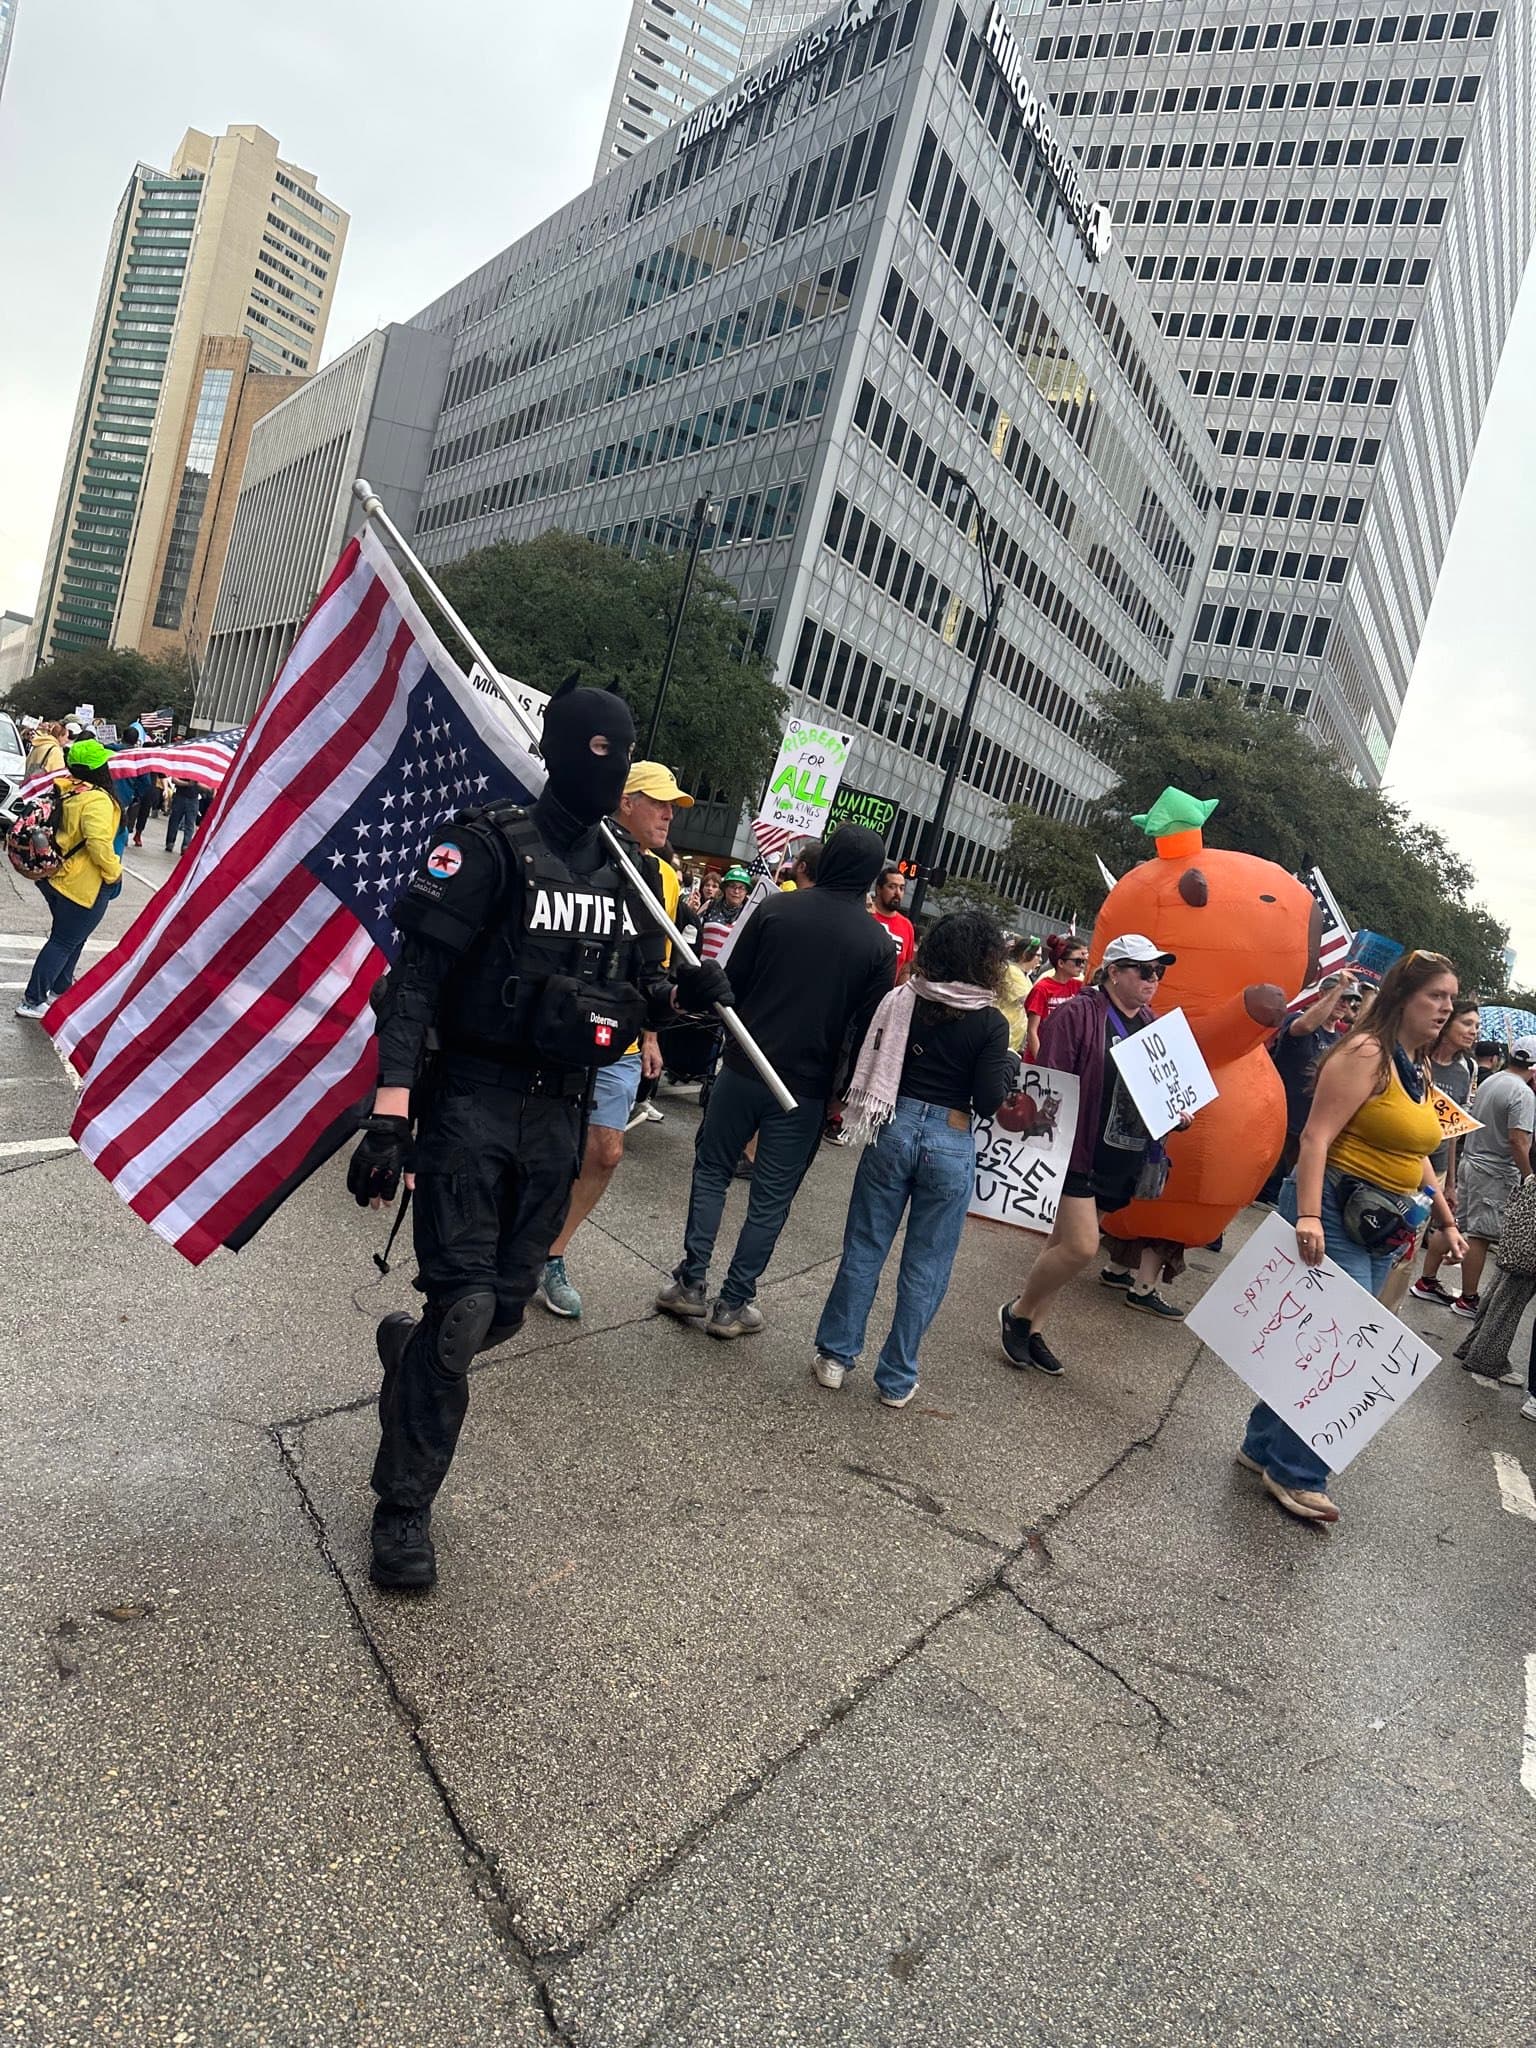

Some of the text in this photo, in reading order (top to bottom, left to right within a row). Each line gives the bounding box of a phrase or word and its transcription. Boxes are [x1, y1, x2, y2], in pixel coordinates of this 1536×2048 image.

[675, 25, 833, 154] HilltopSecurities
[985, 1, 1087, 227] HilltopSecurities
[473, 675, 505, 701] MIK
[783, 728, 846, 766] RIBBERTY
[798, 752, 825, 768] FOR
[771, 765, 831, 808] ALL
[773, 810, 812, 828] 10-18-25
[795, 803, 820, 817] KINGS
[832, 808, 849, 820] WE
[837, 790, 894, 822] UNITED
[530, 889, 638, 936] ANTIFA
[590, 1011, 618, 1028] Doberman
[1141, 1033, 1166, 1063] NO
[1148, 1059, 1179, 1084] king
[1166, 1078, 1180, 1096] but
[1165, 1085, 1197, 1119] JESUS
[970, 1114, 1056, 1192] RGLE
[976, 1151, 1008, 1180] EZ
[1251, 1268, 1335, 1359] We Deport
[1295, 1318, 1343, 1371] Kings
[1294, 1323, 1384, 1409] We Depose
[1312, 1335, 1419, 1447] In America
